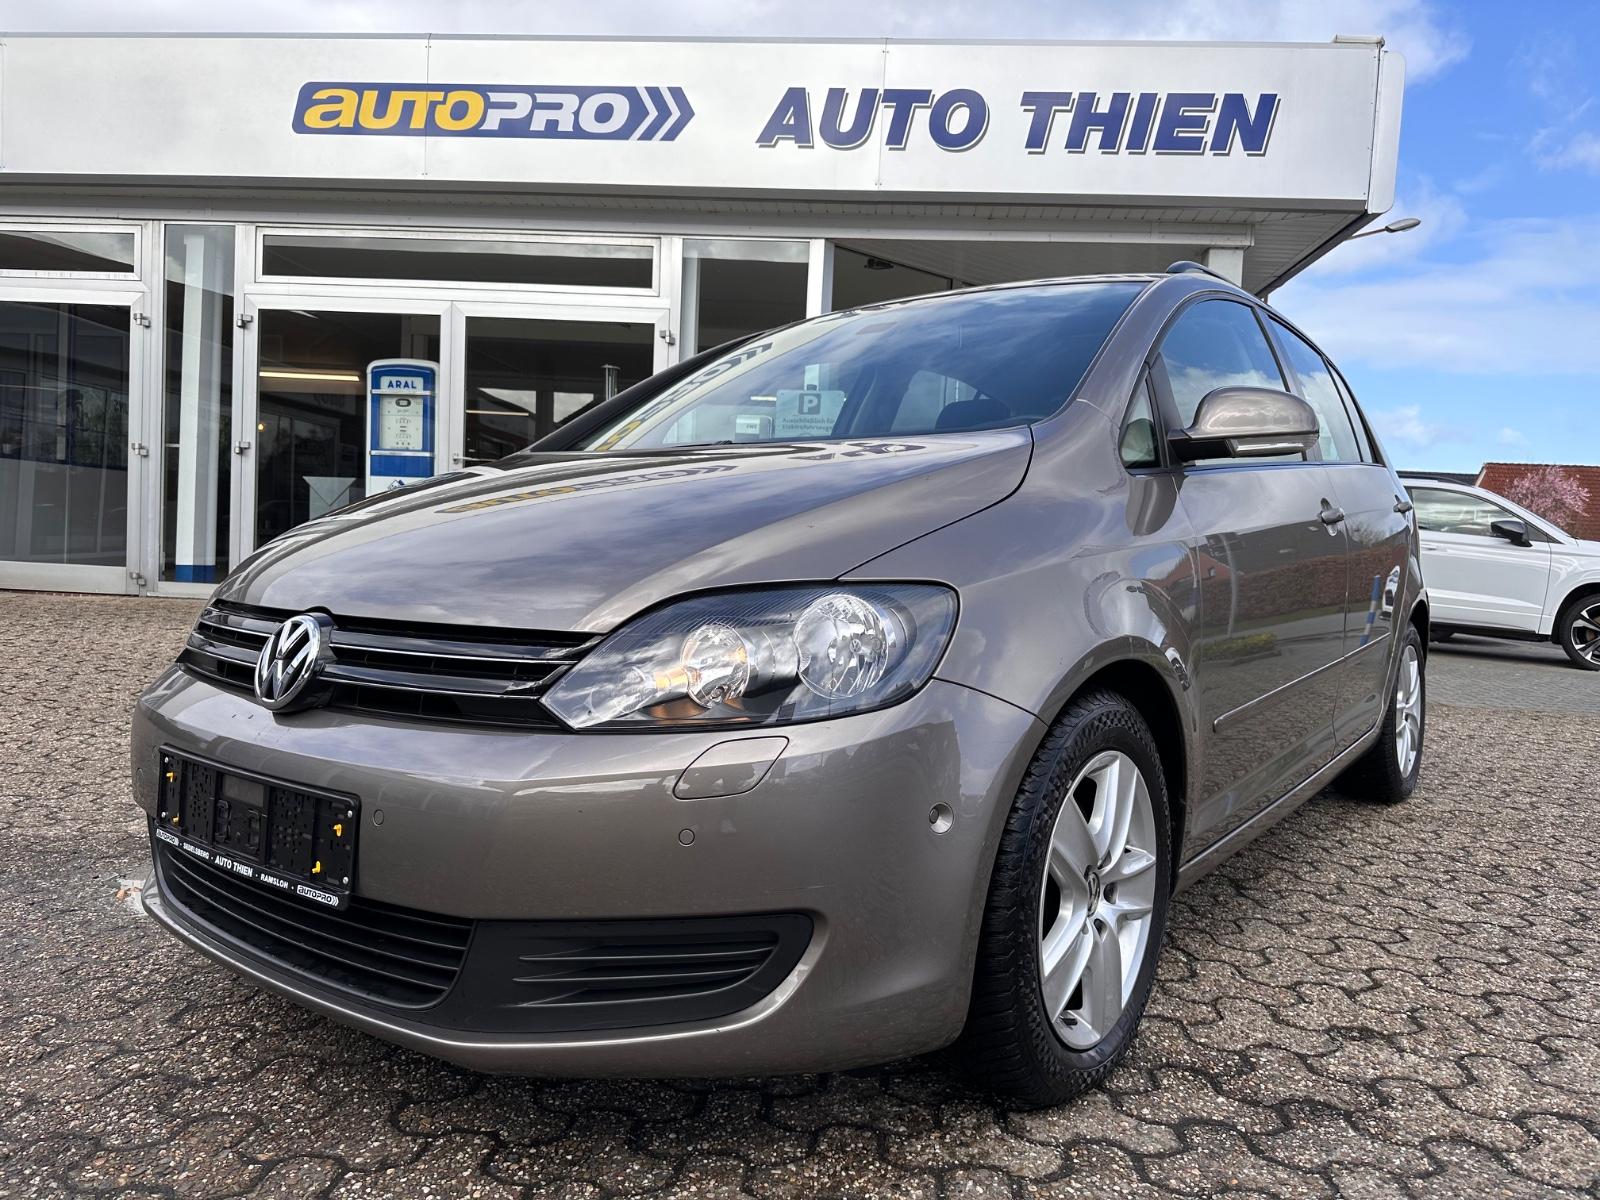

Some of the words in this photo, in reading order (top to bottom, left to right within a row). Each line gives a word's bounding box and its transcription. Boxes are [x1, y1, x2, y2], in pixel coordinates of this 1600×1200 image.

[756, 86, 991, 152] AUTO
[1019, 91, 1280, 157] THIEN
[387, 380, 417, 389] ARAL
[803, 395, 818, 413] P
[214, 855, 232, 869] AUTO
[232, 861, 253, 878] THIEN
[260, 873, 289, 890] RAMSLOH
